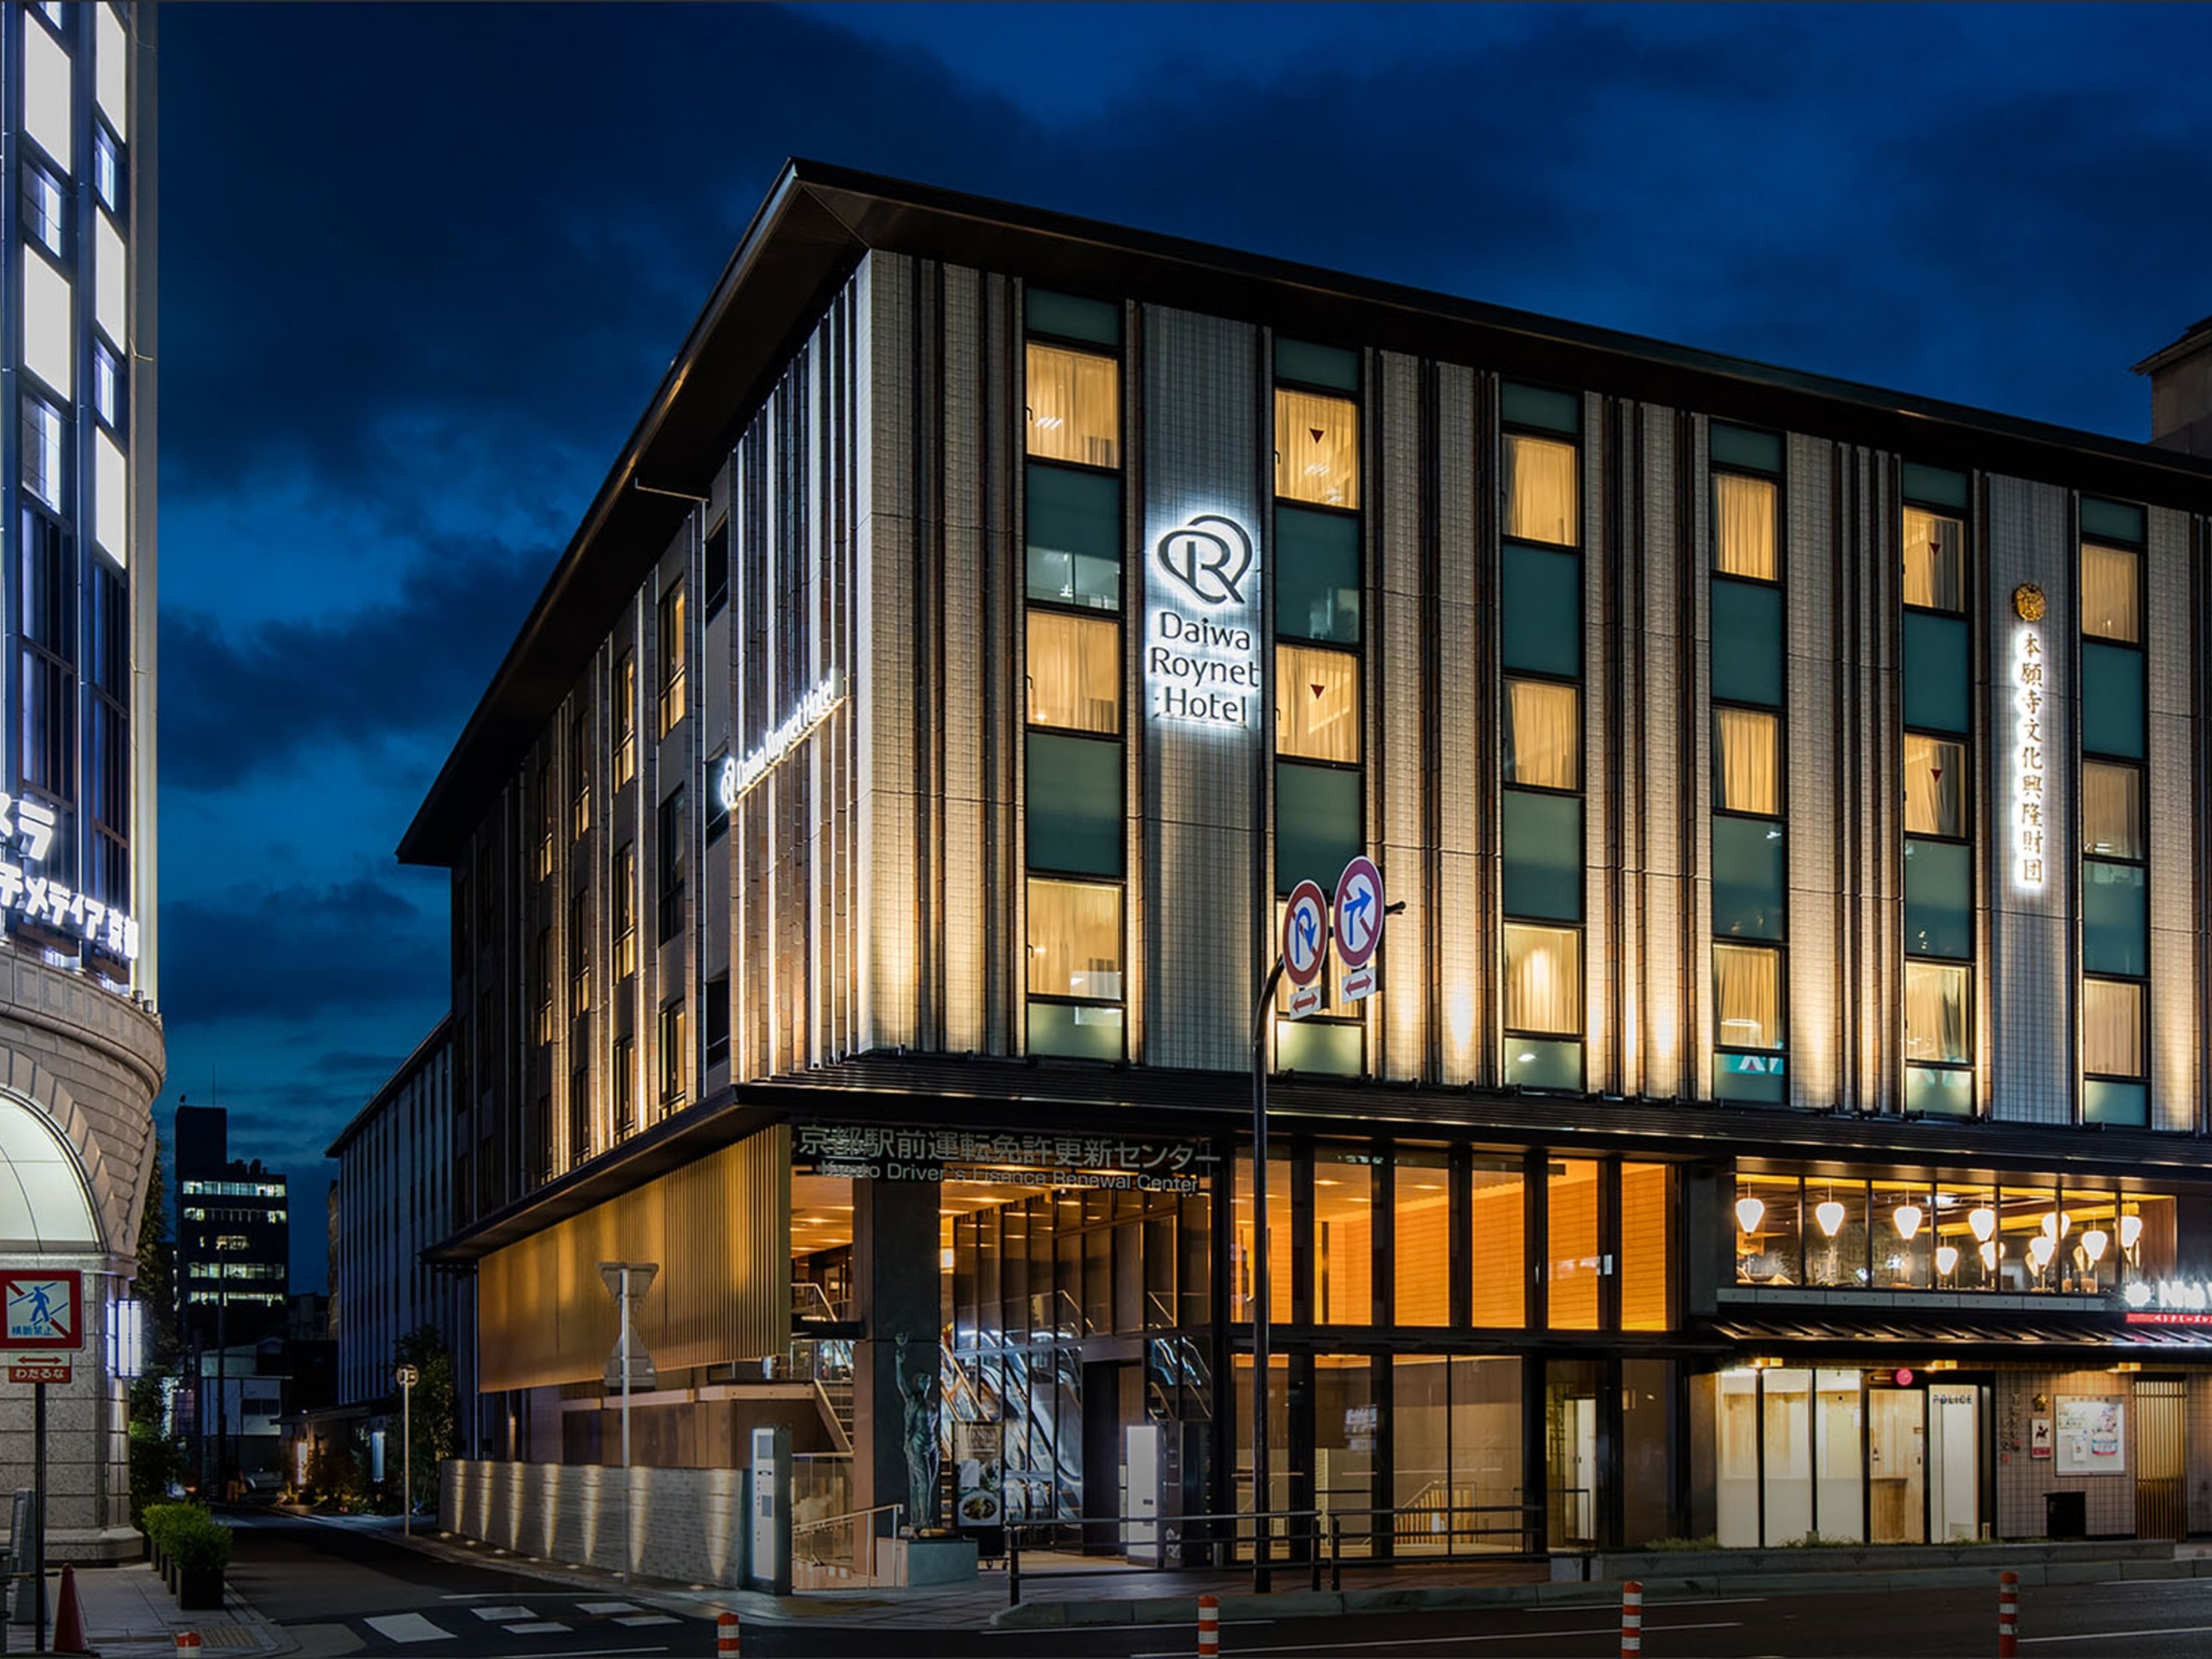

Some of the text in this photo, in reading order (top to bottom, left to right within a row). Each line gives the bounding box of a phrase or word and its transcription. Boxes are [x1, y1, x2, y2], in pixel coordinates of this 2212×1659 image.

[1160, 612, 1250, 650] Daiwa
[1150, 647, 1259, 687] Roynet
[1165, 686, 1245, 722] Hotel
[2021, 632, 2043, 883] 本願寺文化興隆財団
[798, 1124, 1221, 1171] 京都駅前運転免許更新センター
[1052, 1171, 1131, 1190] Renewal
[1137, 1173, 1198, 1191] Center
[1933, 1394, 1972, 1405] POLICE
